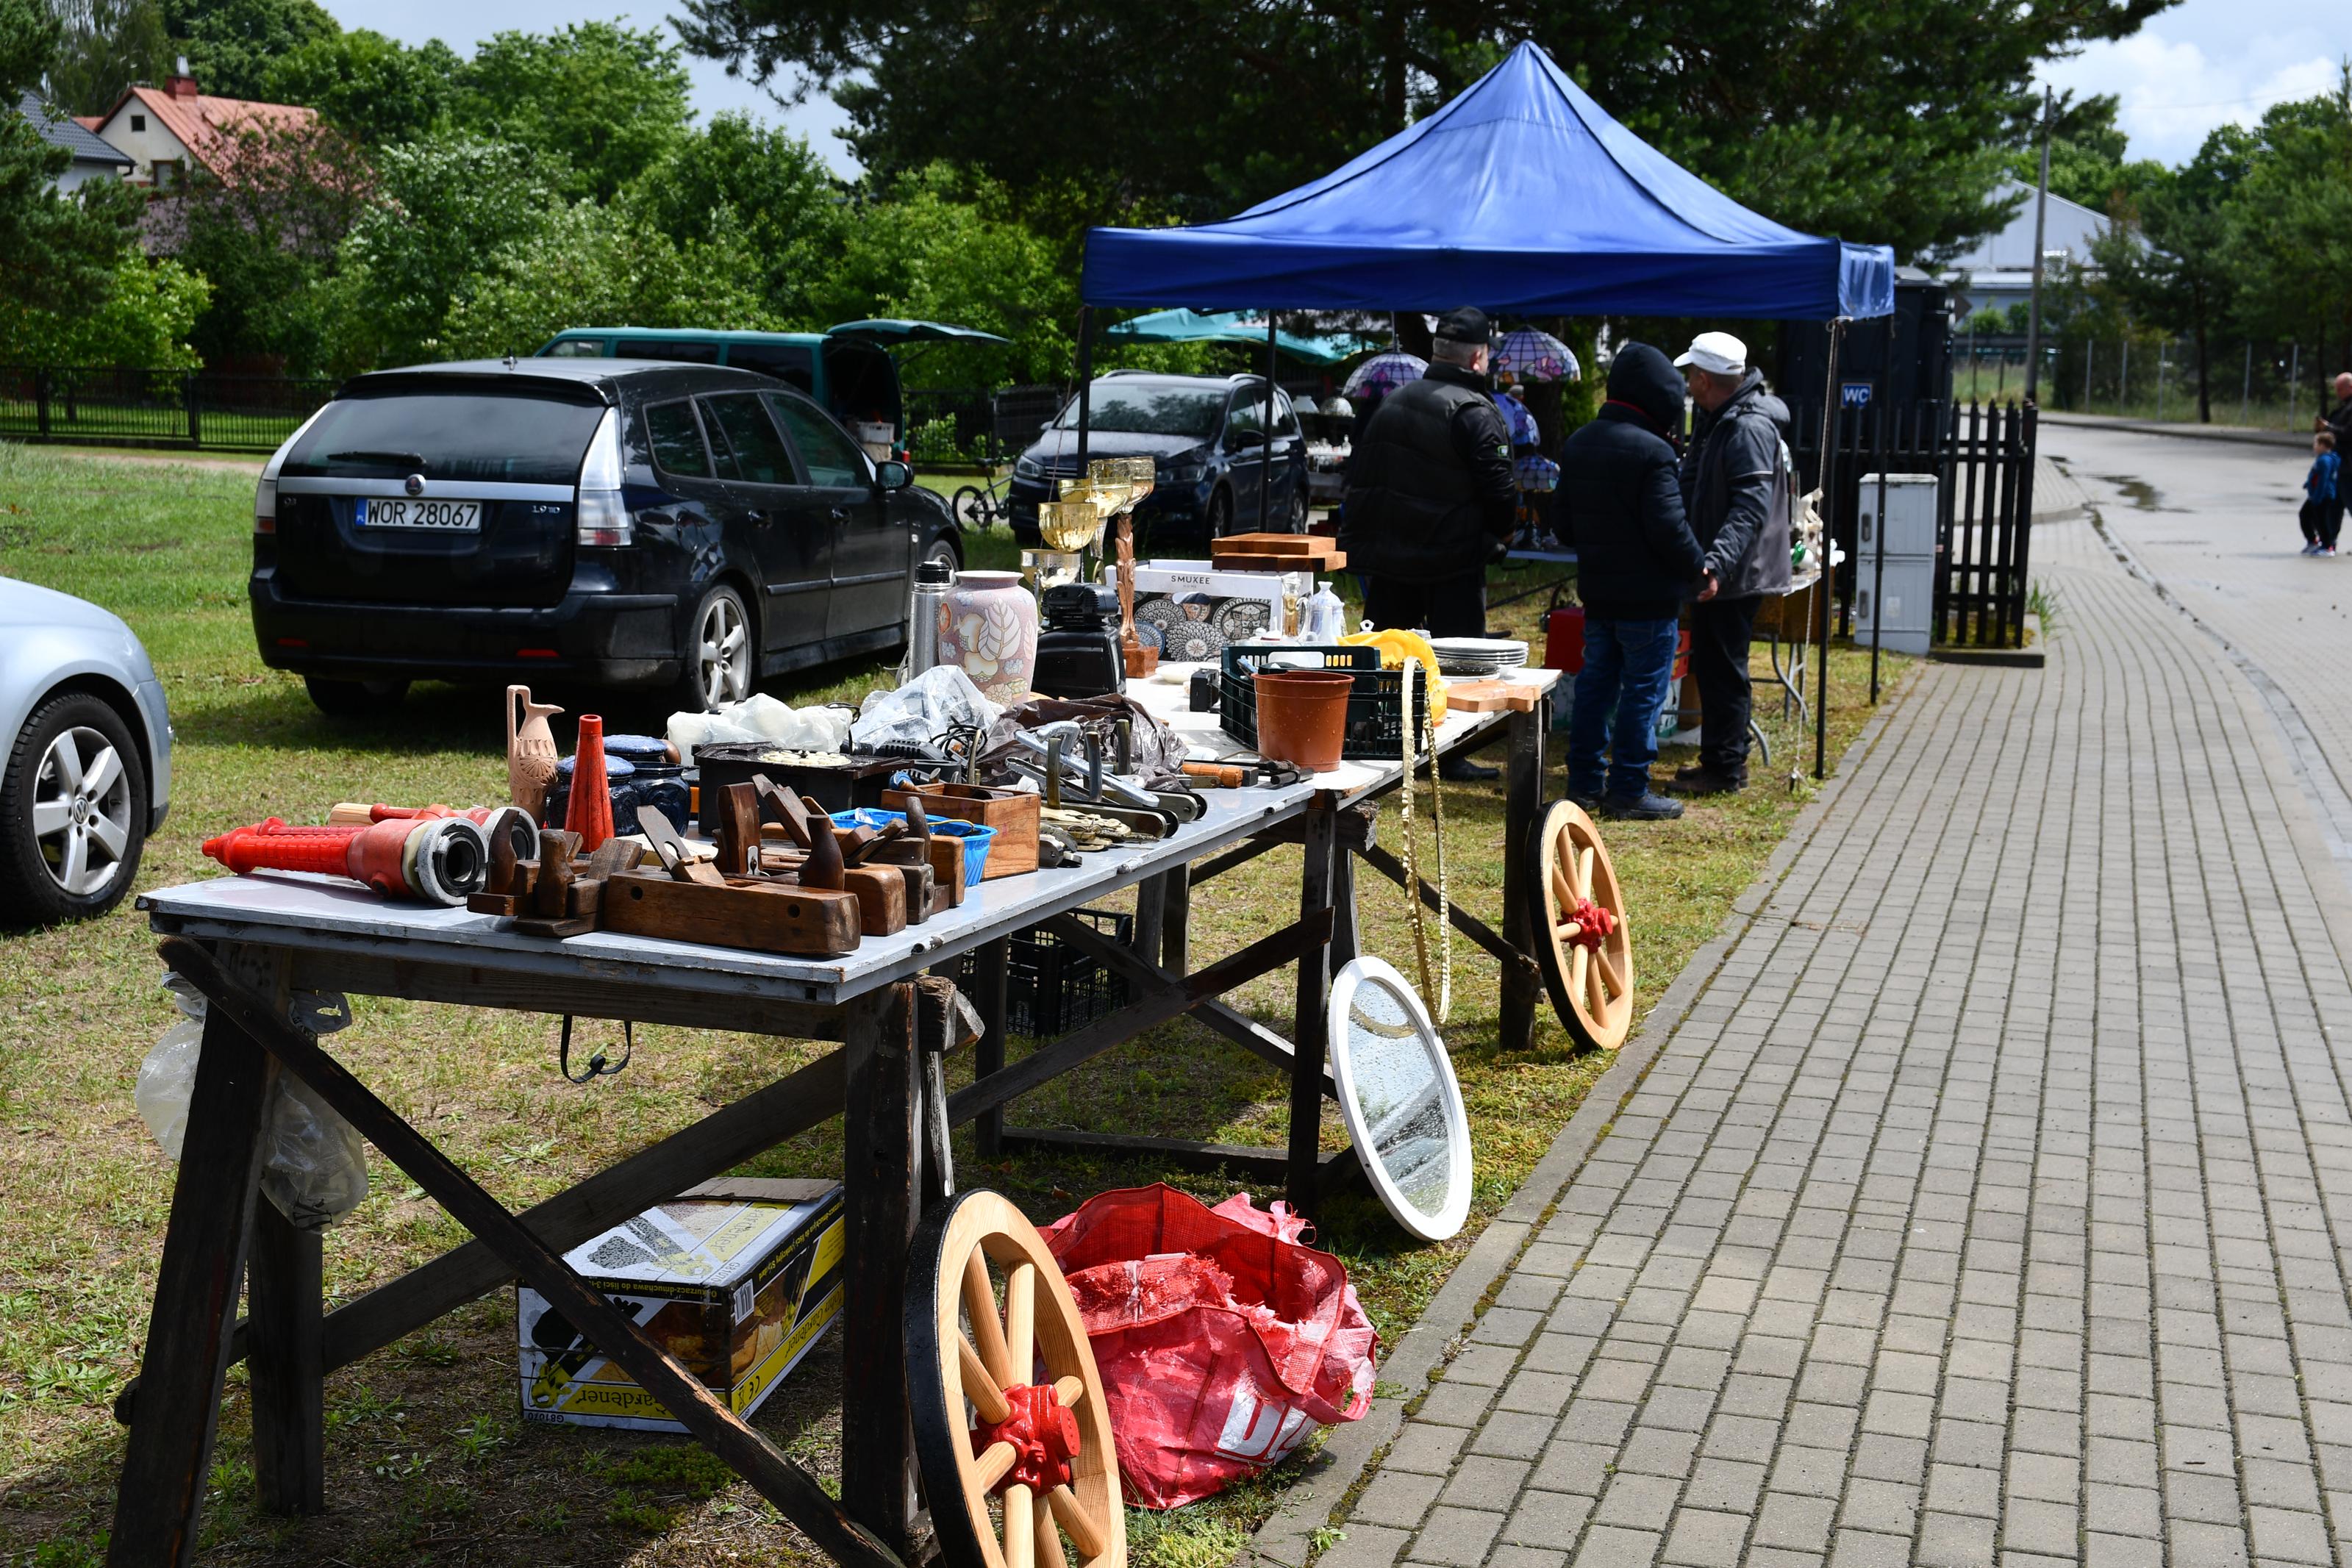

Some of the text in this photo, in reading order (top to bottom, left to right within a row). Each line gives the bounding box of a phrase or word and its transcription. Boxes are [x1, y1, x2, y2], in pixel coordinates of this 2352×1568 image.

[1844, 387, 1869, 403] WC
[368, 501, 478, 527] WOR 28067
[710, 1262, 741, 1282] G81070
[621, 1283, 631, 1292] do
[633, 1283, 718, 1298] Okurzacz-dmuchawa
[528, 1412, 565, 1423] G81070
